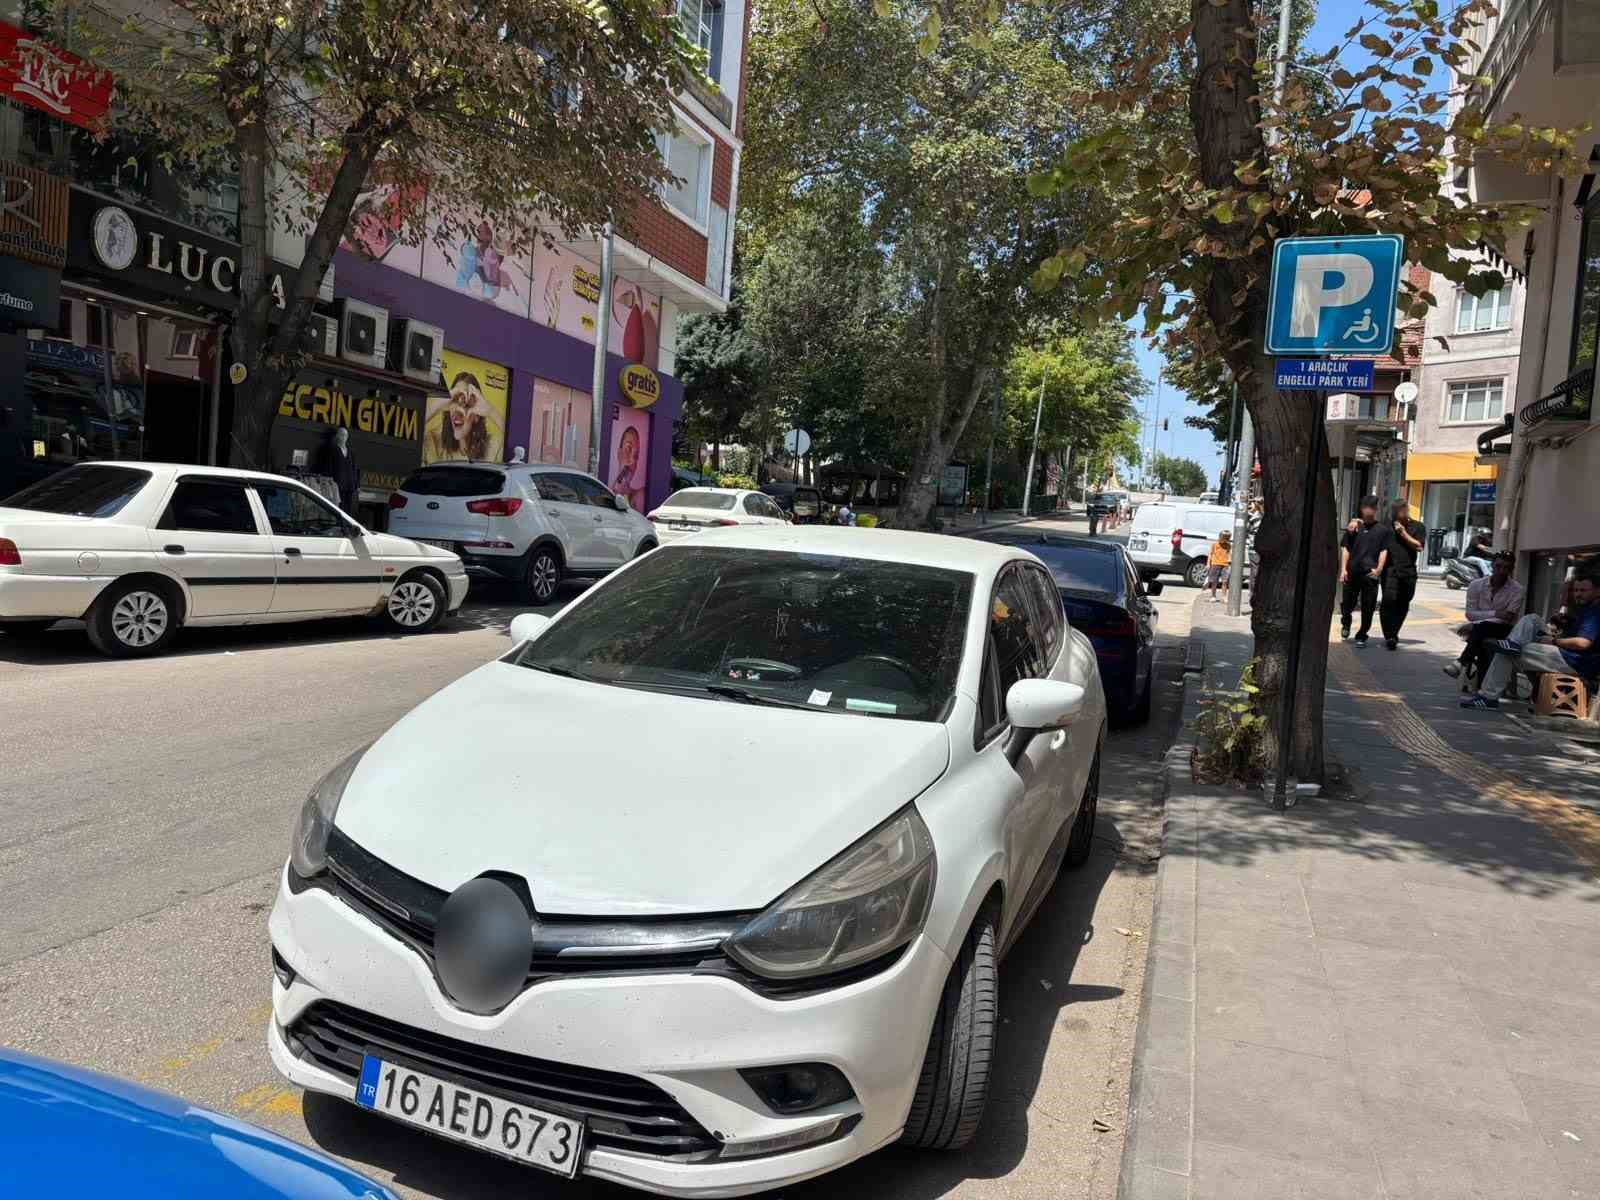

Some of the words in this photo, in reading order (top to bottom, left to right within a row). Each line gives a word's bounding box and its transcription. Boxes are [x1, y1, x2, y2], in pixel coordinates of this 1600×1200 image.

[147, 231, 287, 310] LUCA
[1289, 253, 1374, 338] P
[1300, 362, 1305, 372] 1
[1307, 362, 1349, 375] ARAÇLIK
[628, 371, 656, 393] gratis
[1278, 374, 1316, 386] ENGELLİ
[1318, 375, 1345, 386] PARK
[1347, 375, 1368, 387] YERİ
[362, 1083, 375, 1097] TR
[384, 1069, 421, 1115] 16
[425, 1084, 493, 1139] AED
[501, 1107, 572, 1164] 673
